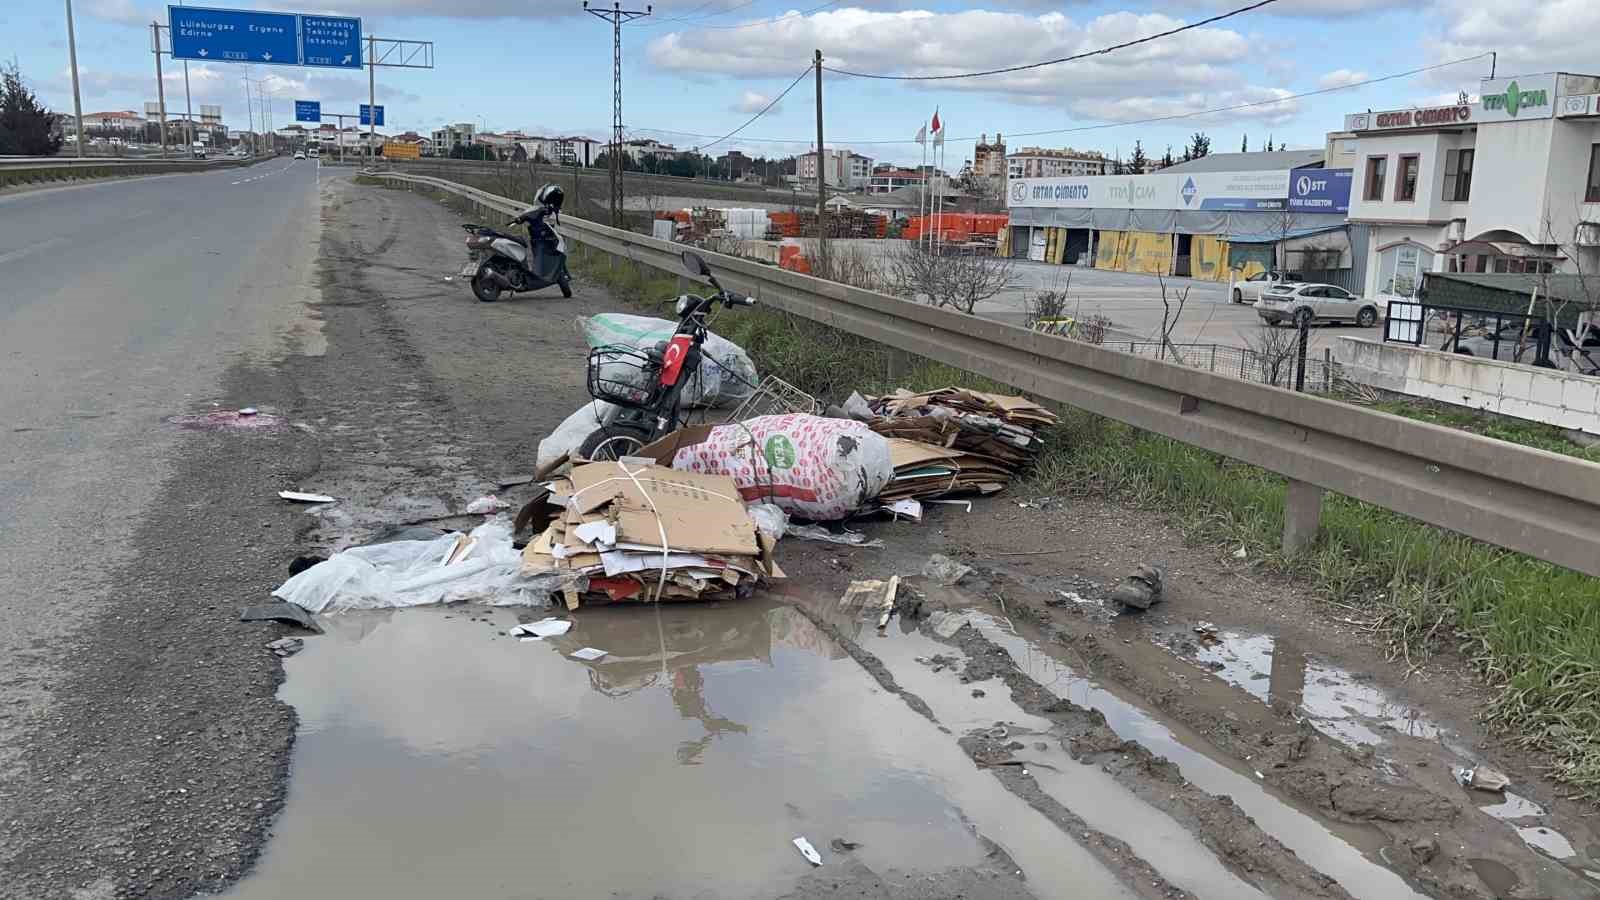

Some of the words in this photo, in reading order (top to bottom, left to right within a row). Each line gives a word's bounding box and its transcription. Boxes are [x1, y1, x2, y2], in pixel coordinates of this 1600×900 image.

[180, 28, 212, 36] Edirne
[249, 24, 284, 33] Ergene
[1311, 180, 1327, 192] STT
[1033, 184, 1053, 200] ERTAN
